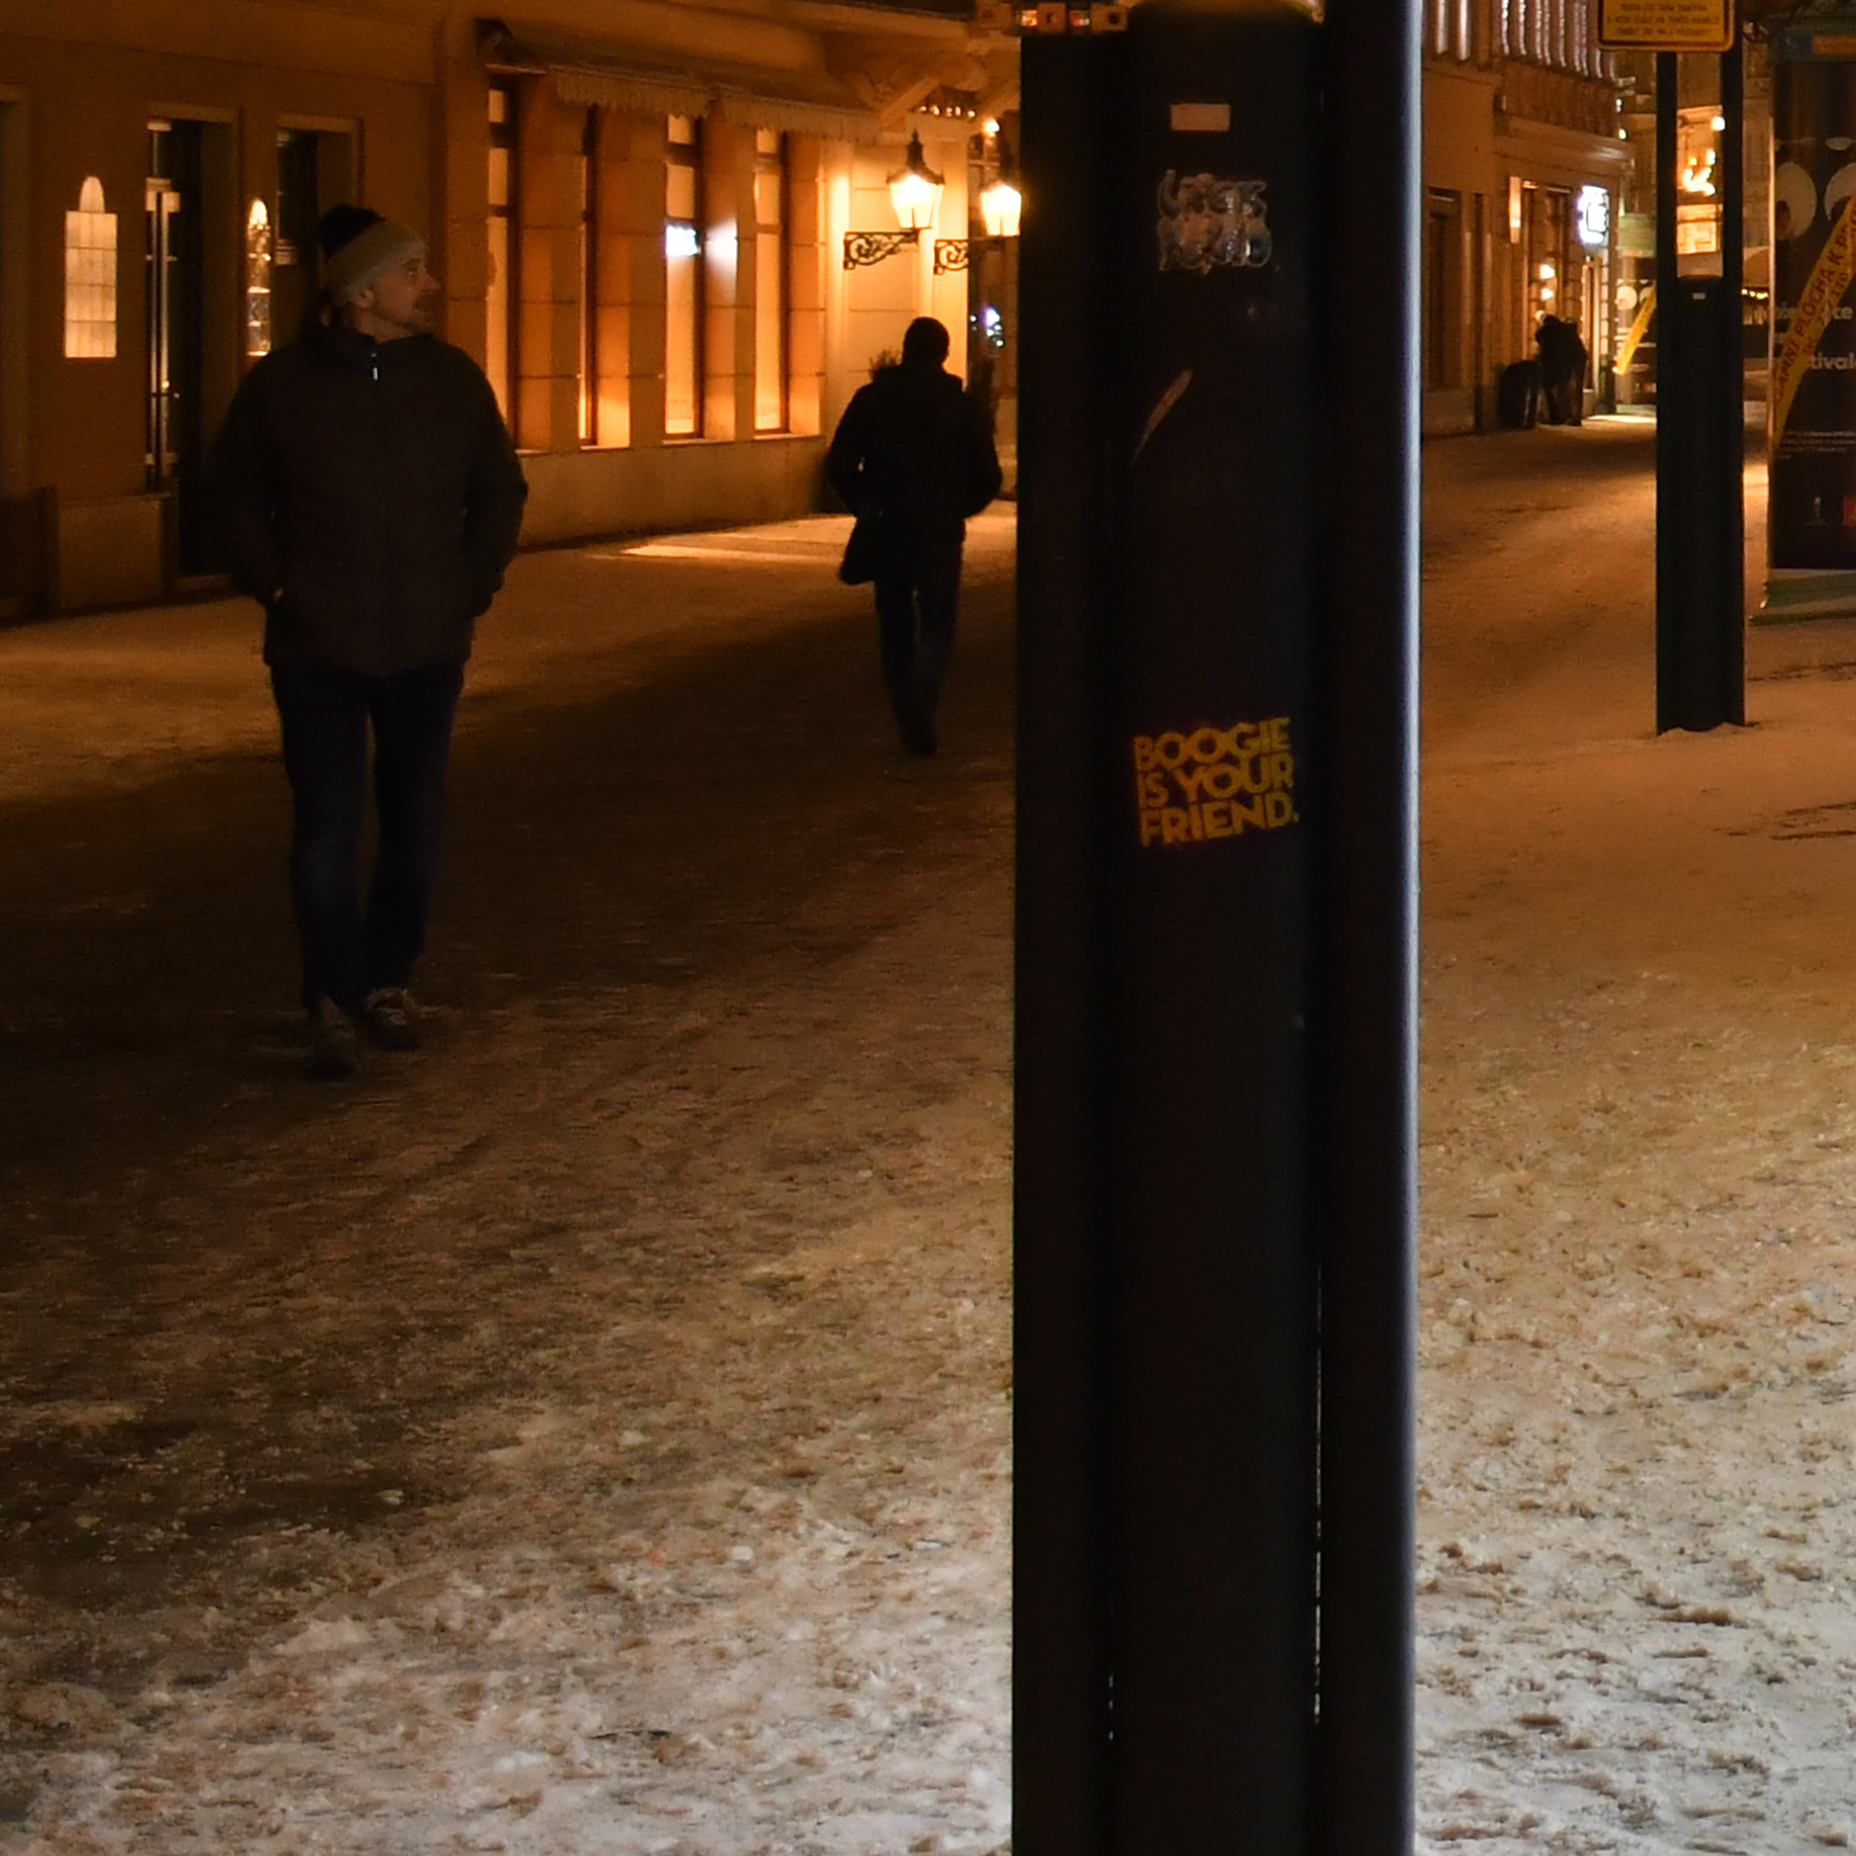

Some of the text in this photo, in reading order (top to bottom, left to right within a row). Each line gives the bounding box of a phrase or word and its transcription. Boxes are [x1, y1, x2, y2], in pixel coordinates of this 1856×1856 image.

[1133, 715, 1292, 772] BOOGIE
[1135, 752, 1294, 810] IS YOUR
[1138, 789, 1301, 848] FRIEND.
